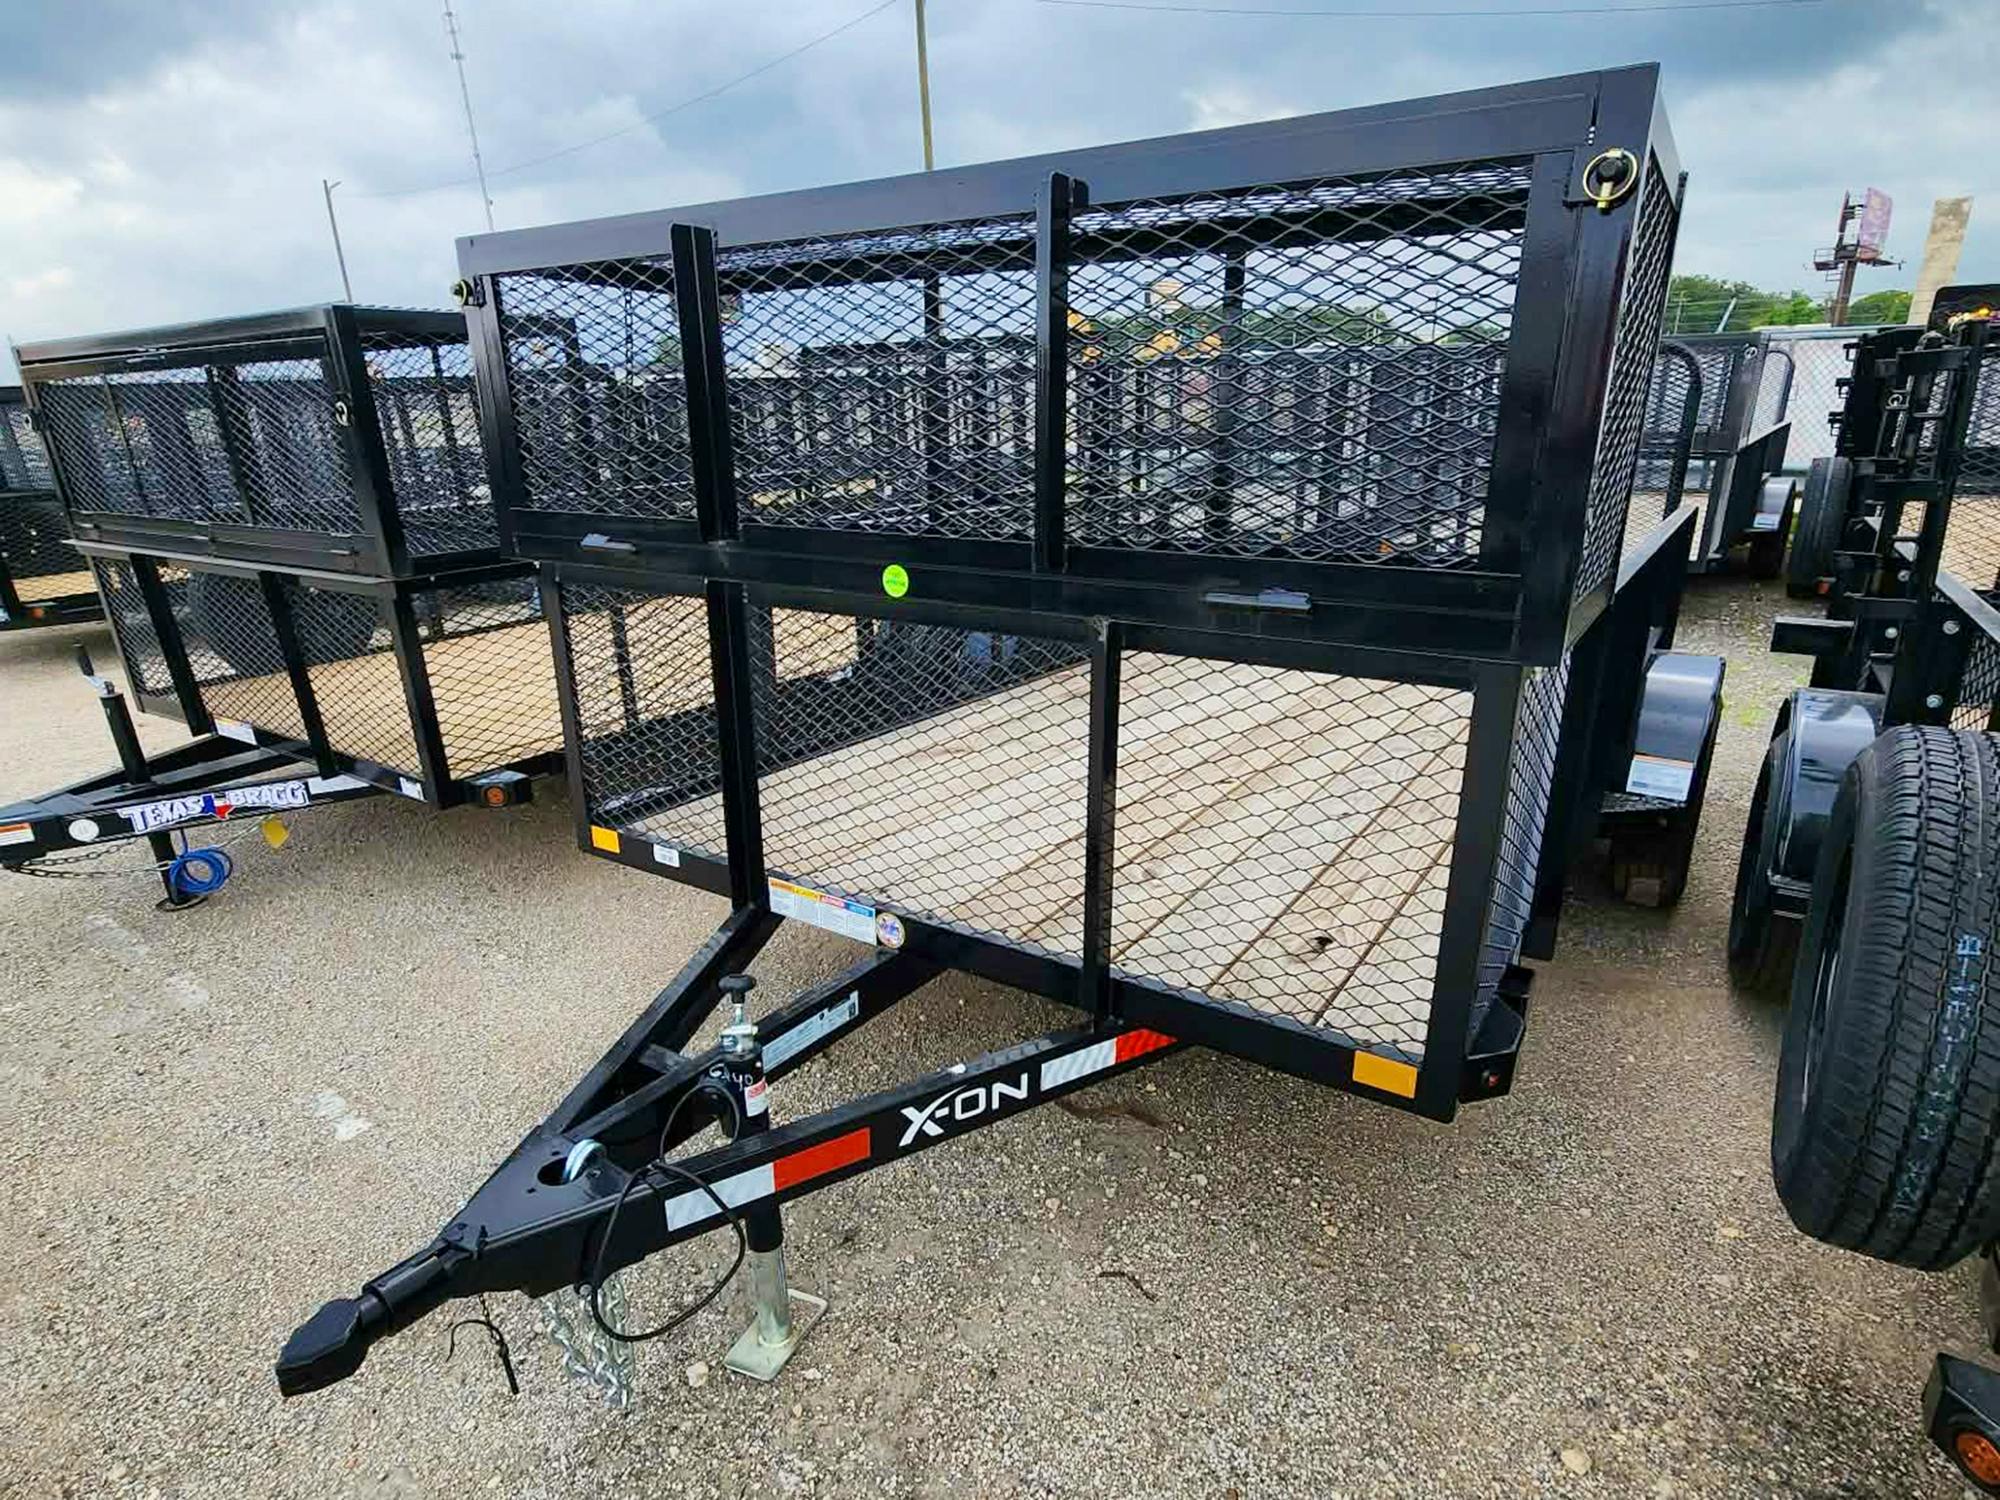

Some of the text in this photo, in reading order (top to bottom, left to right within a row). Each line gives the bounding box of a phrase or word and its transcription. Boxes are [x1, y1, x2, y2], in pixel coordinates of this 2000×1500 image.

[116, 795, 201, 834] TEXAS
[226, 780, 309, 806] BRAGG
[899, 1072, 1028, 1147] X-ON
